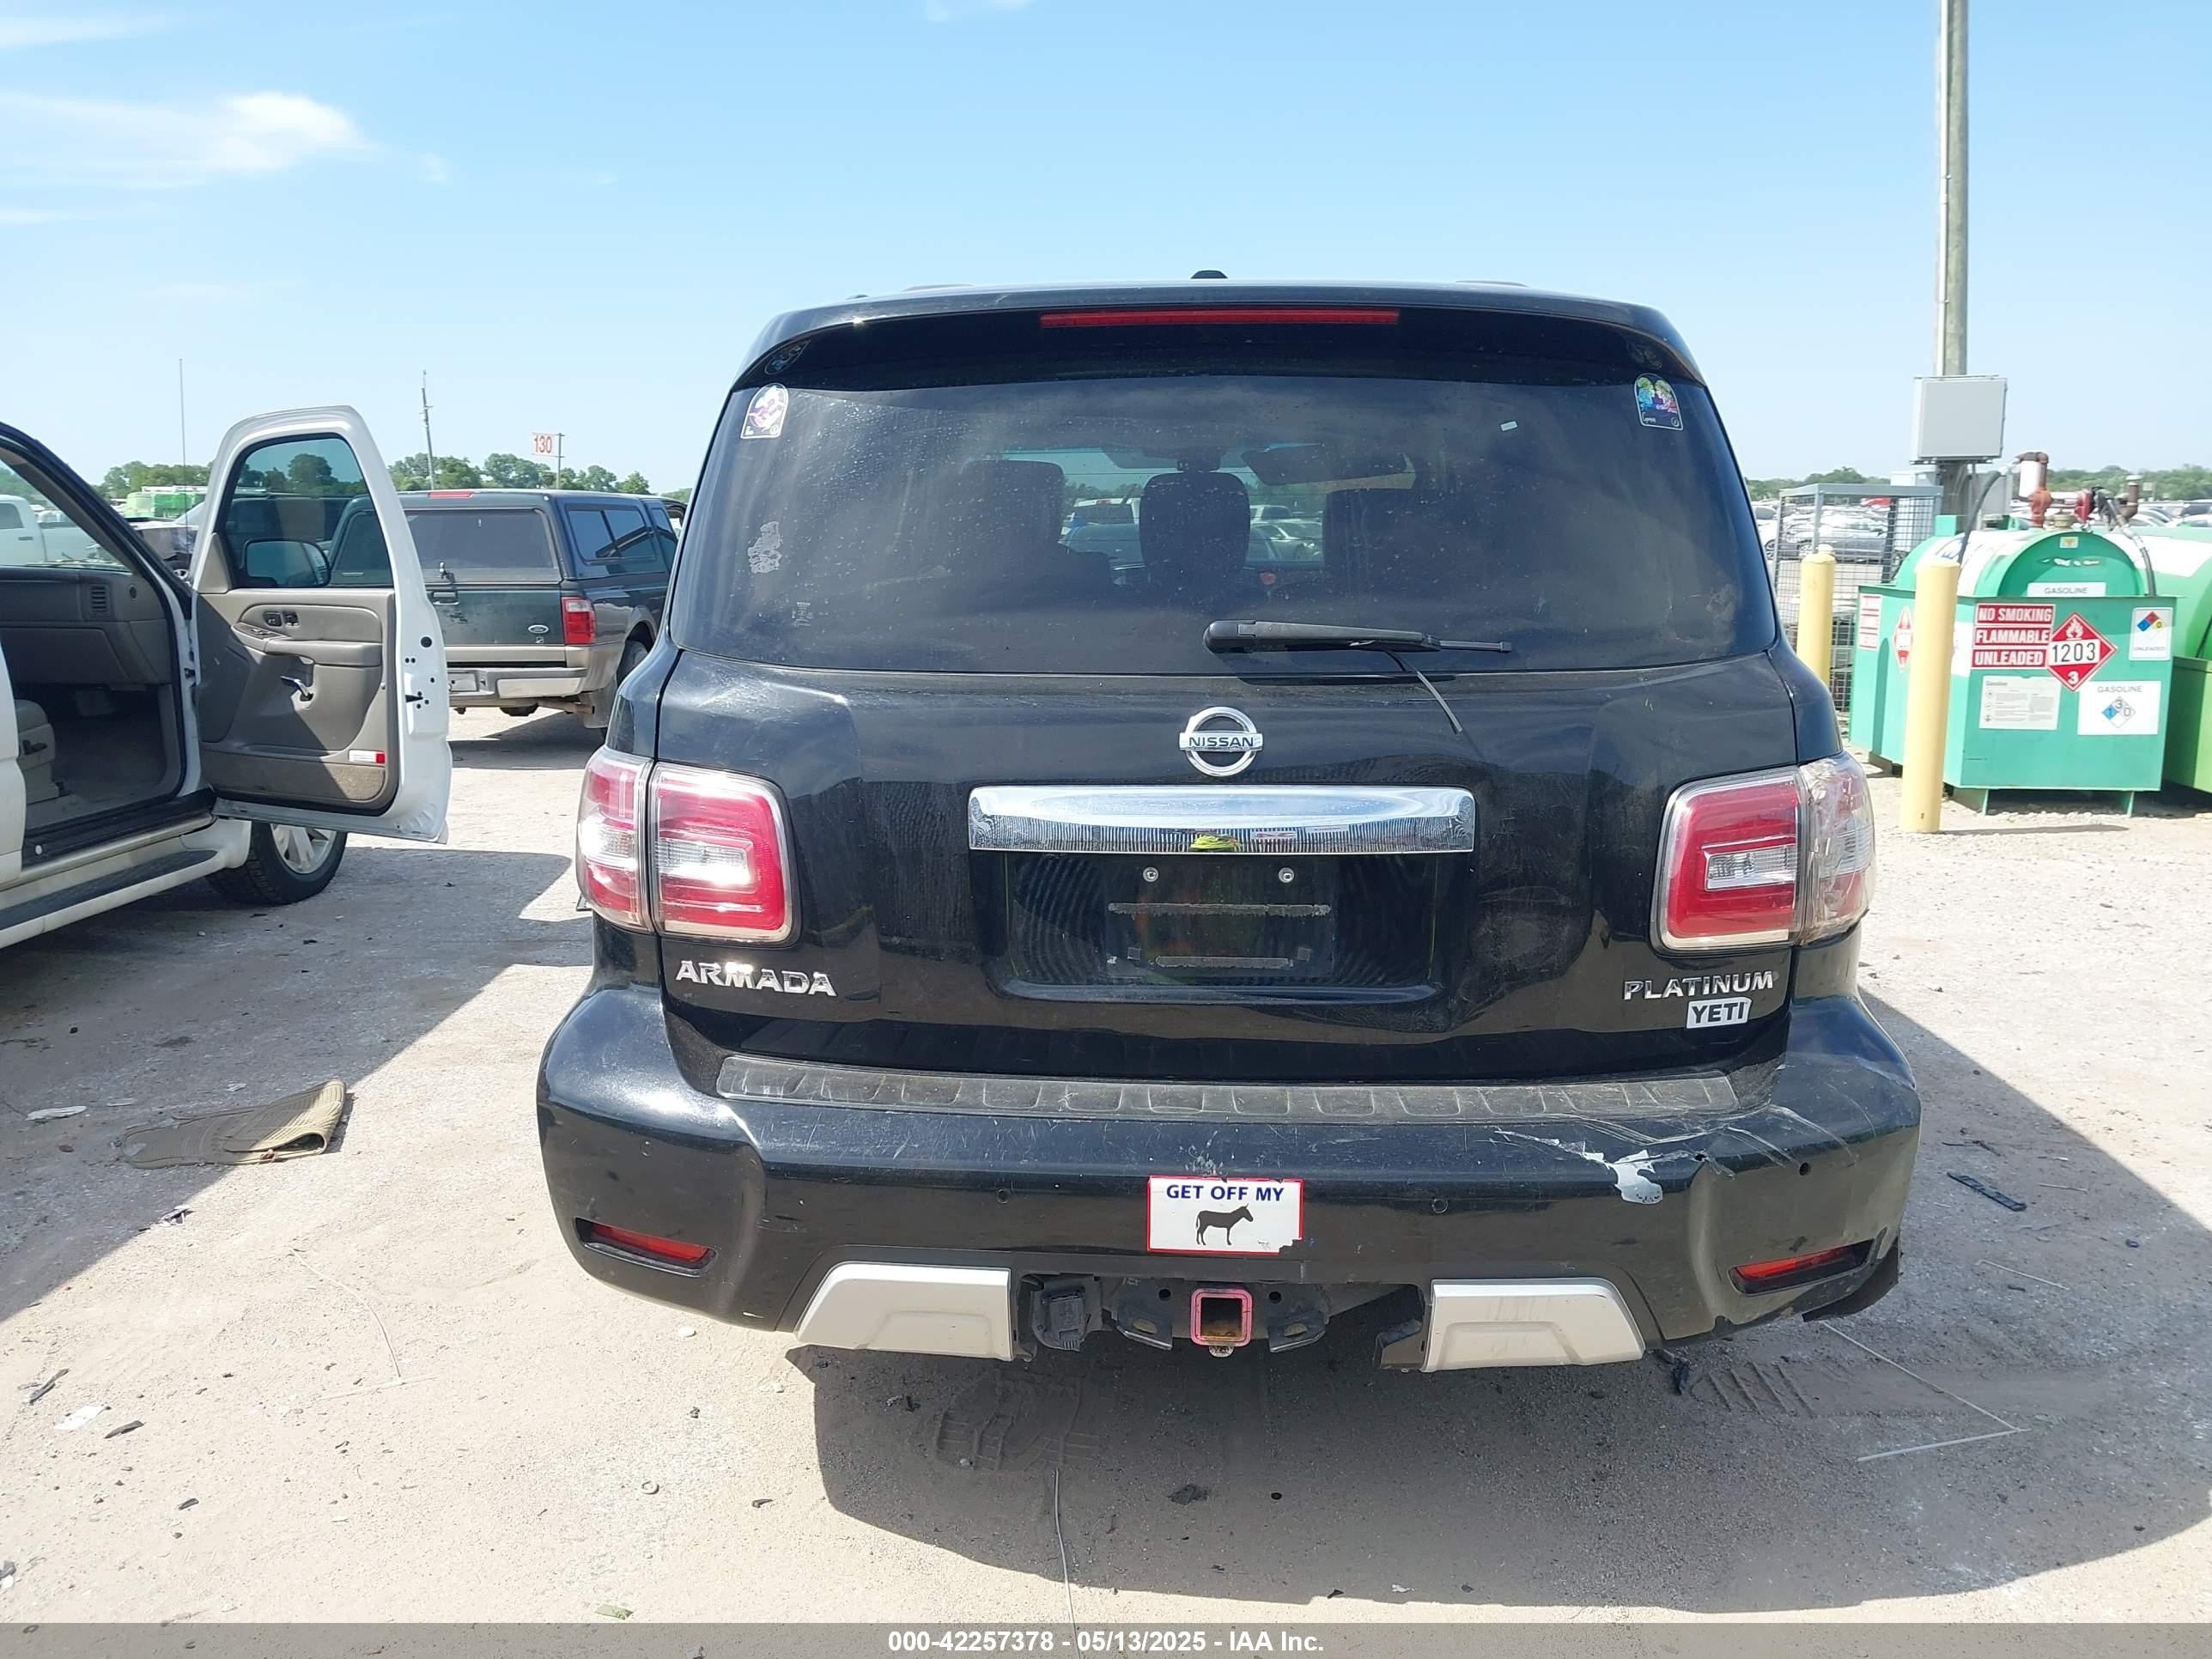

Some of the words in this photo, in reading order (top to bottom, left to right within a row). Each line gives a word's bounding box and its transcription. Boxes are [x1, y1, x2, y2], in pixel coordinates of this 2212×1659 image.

[534, 434, 552, 453] 130
[1978, 608, 1996, 622] NO
[1998, 608, 2052, 622] SMOKING
[1976, 629, 2050, 644] FLAMMABLE
[1975, 651, 2044, 665] UNLEADED
[2052, 641, 2096, 663] 1203
[2068, 671, 2080, 685] 3
[2115, 699, 2124, 709] 3
[2124, 708, 2131, 717] 0
[1188, 737, 1254, 747] NISSAN
[675, 960, 838, 997] ARMADA
[1624, 971, 1773, 1000] PLATINUM
[1692, 1001, 1746, 1024] YETI
[1166, 1184, 1204, 1199] GET
[1210, 1186, 1249, 1200] OFF
[1255, 1188, 1285, 1201] MY
